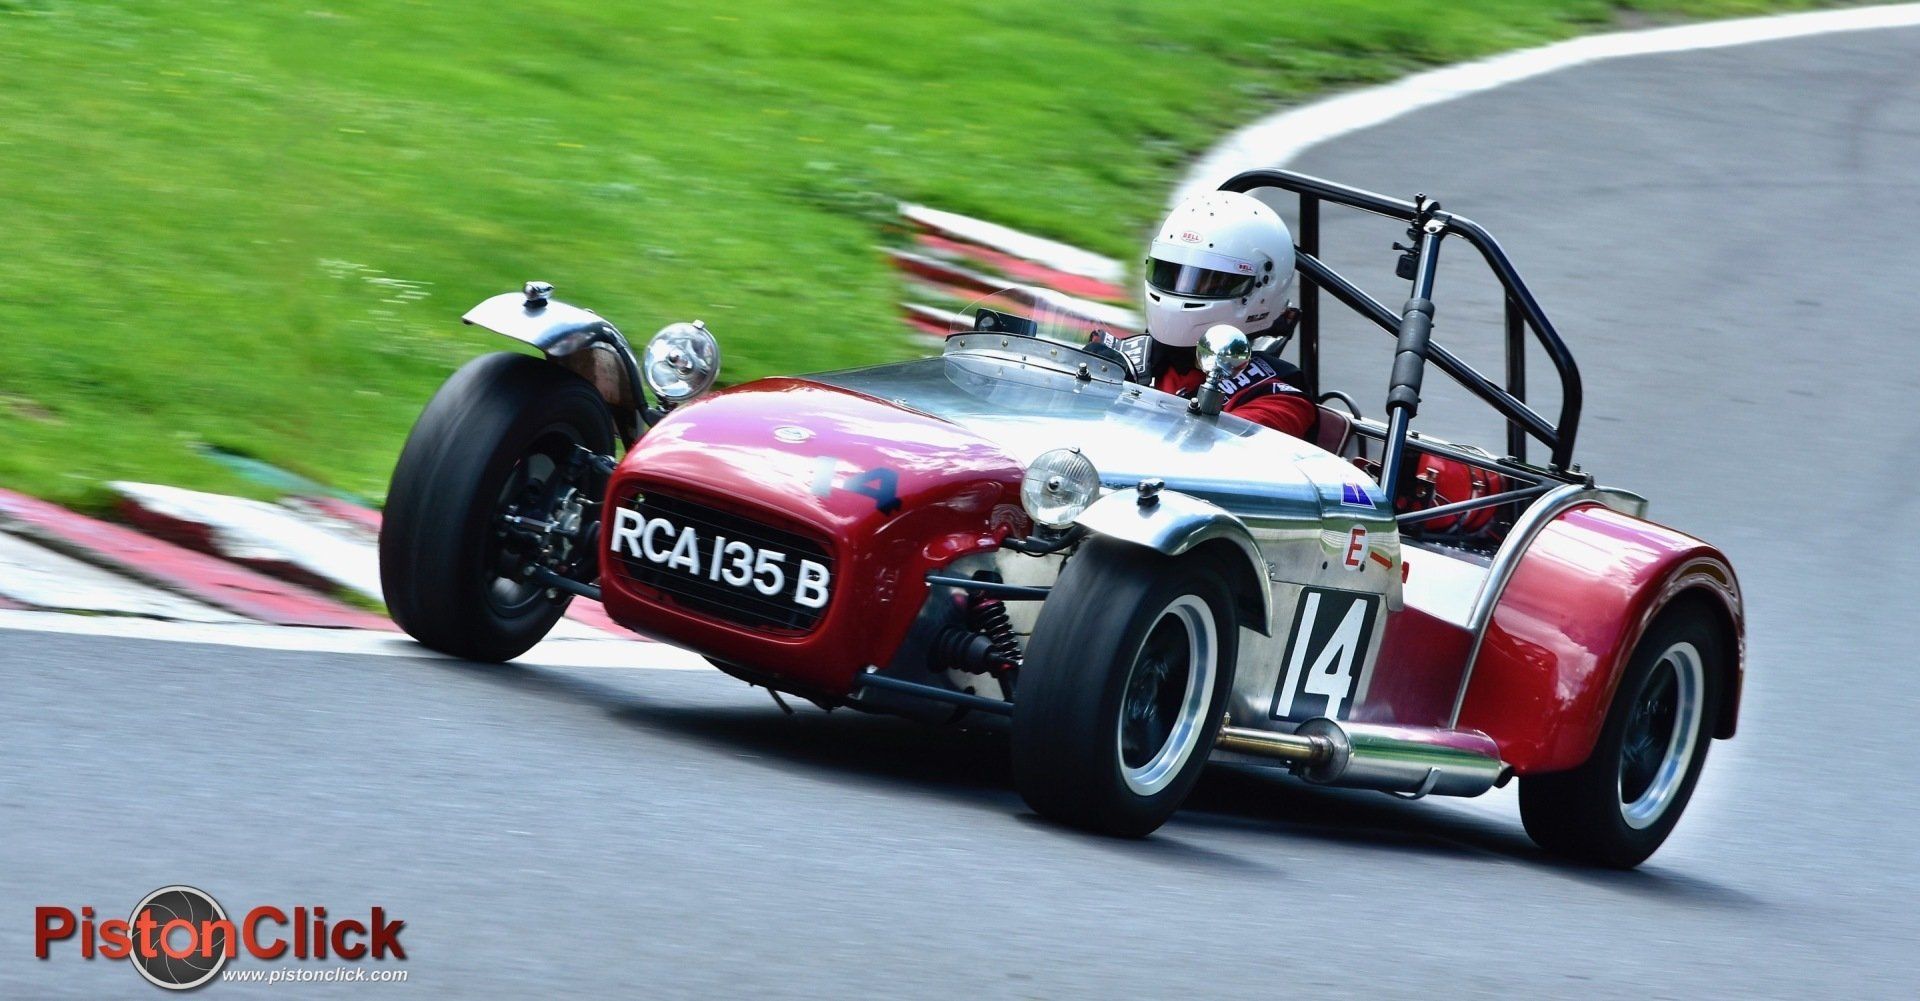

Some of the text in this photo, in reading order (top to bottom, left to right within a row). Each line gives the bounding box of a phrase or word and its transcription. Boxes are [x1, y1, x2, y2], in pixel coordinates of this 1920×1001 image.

[1182, 232, 1200, 241] BELL
[1239, 263, 1253, 271] BELL
[810, 456, 901, 516] 14
[610, 506, 831, 609] RCA 135 B
[1345, 530, 1366, 567] E
[1276, 592, 1368, 718] 14
